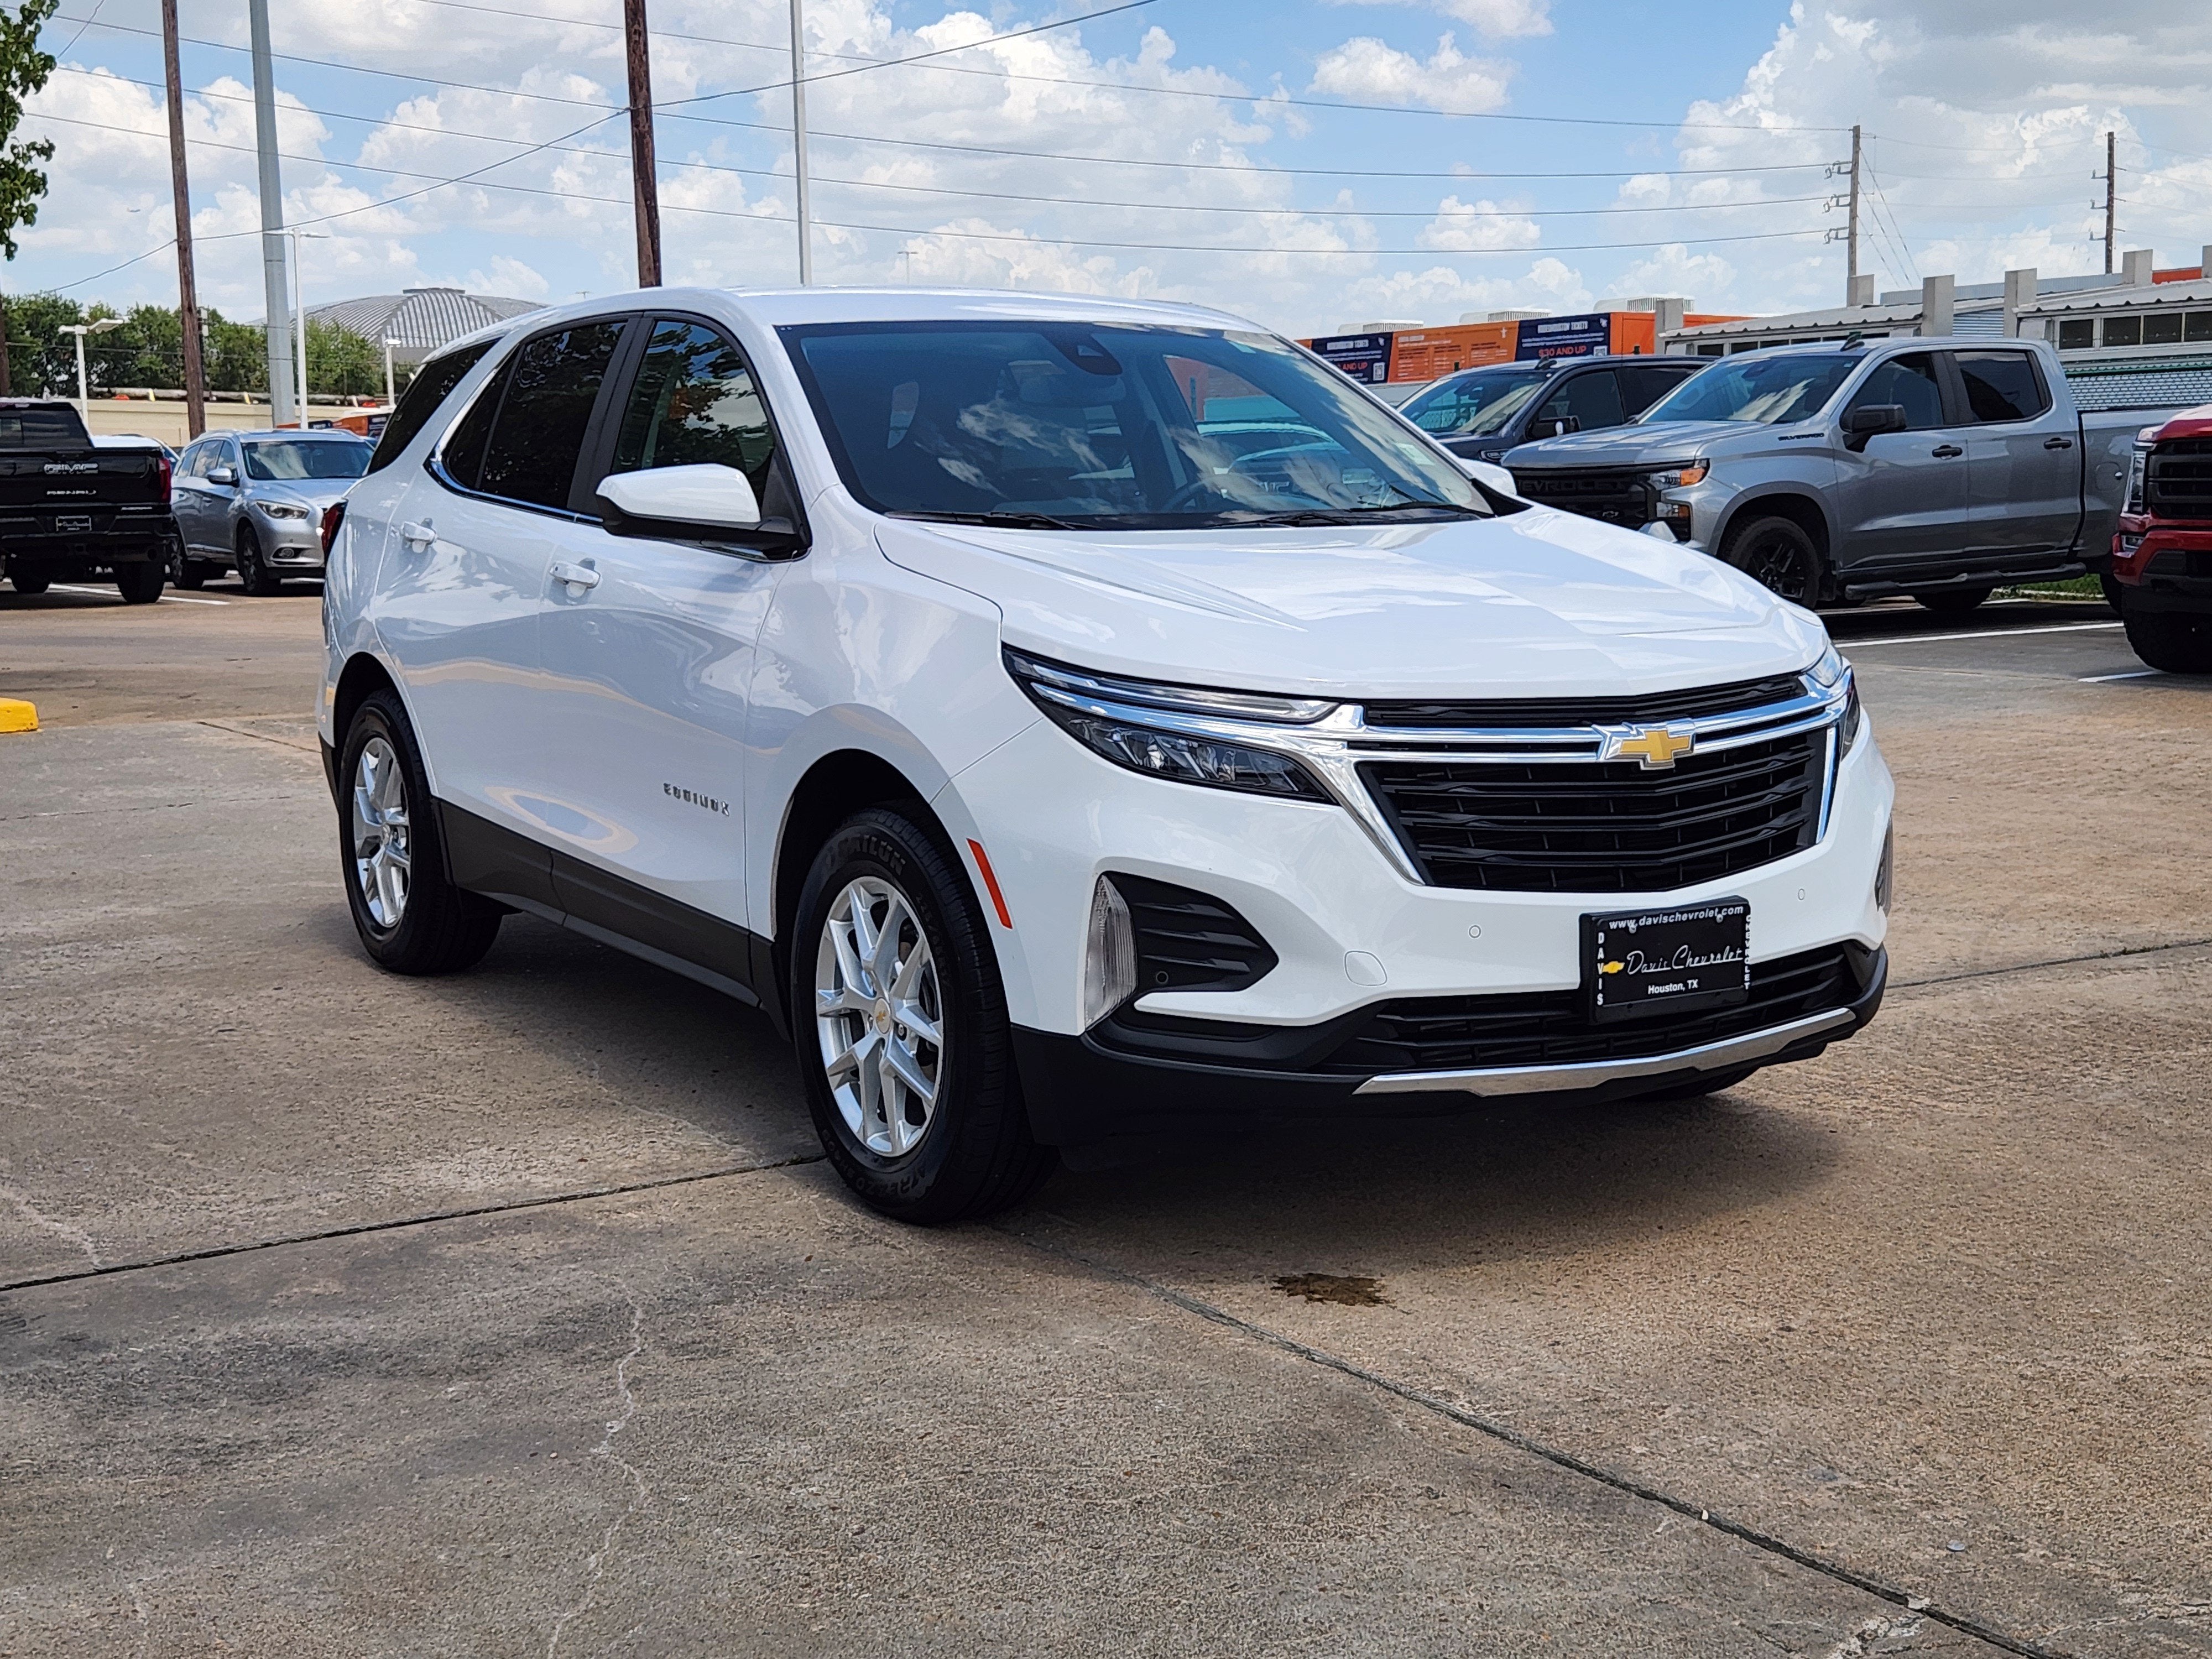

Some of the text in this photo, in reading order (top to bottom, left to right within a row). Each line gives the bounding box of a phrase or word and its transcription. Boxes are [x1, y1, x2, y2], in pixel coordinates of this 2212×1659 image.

[1556, 347, 1574, 356] AND
[1574, 345, 1587, 353] UP
[1358, 362, 1368, 370] UP
[44, 463, 98, 475] GMC
[663, 782, 730, 817] EQUINOX
[1609, 905, 1744, 930] www.davischevrolet.com
[1626, 945, 1743, 975] Davis Chevrolet
[1647, 979, 1699, 995] Houston, TX
